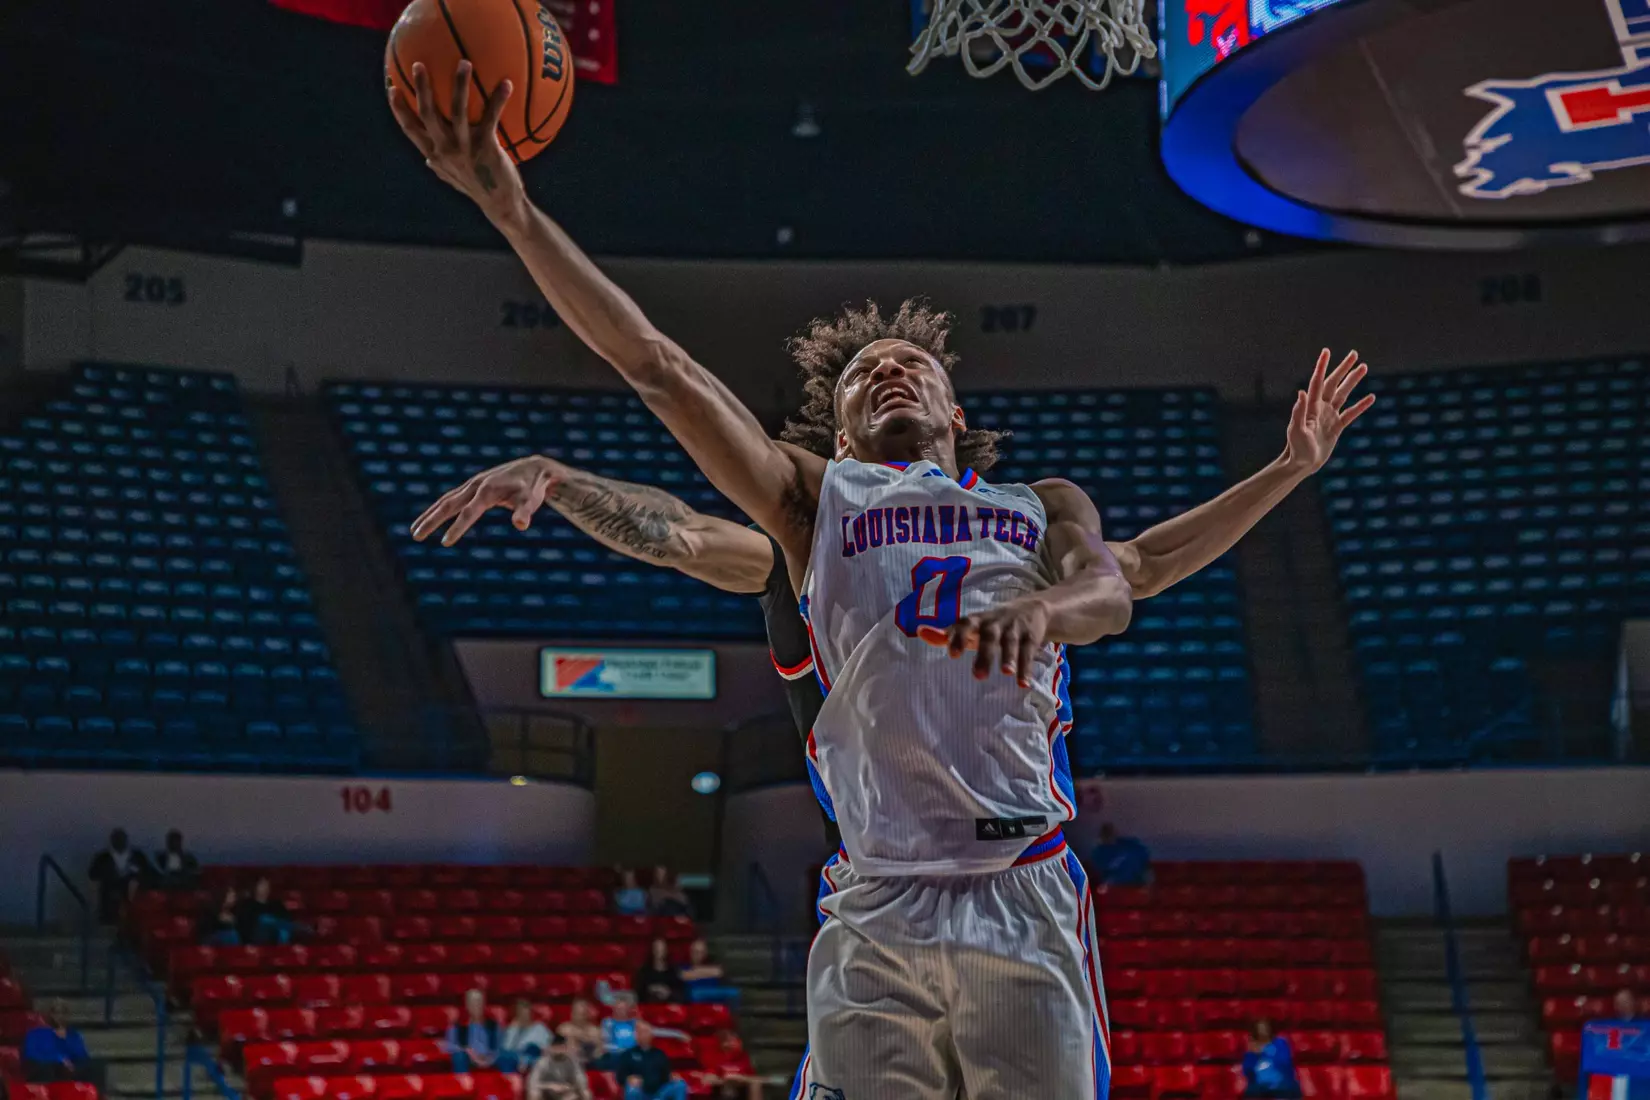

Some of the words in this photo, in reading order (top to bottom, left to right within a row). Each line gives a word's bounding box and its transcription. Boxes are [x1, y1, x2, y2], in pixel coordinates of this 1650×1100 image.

[124, 272, 187, 306] 205
[980, 303, 1037, 333] 207
[842, 505, 972, 557] LOUISIANA
[976, 507, 1039, 552] TECH
[895, 555, 971, 638] 0
[341, 786, 391, 813] 104
